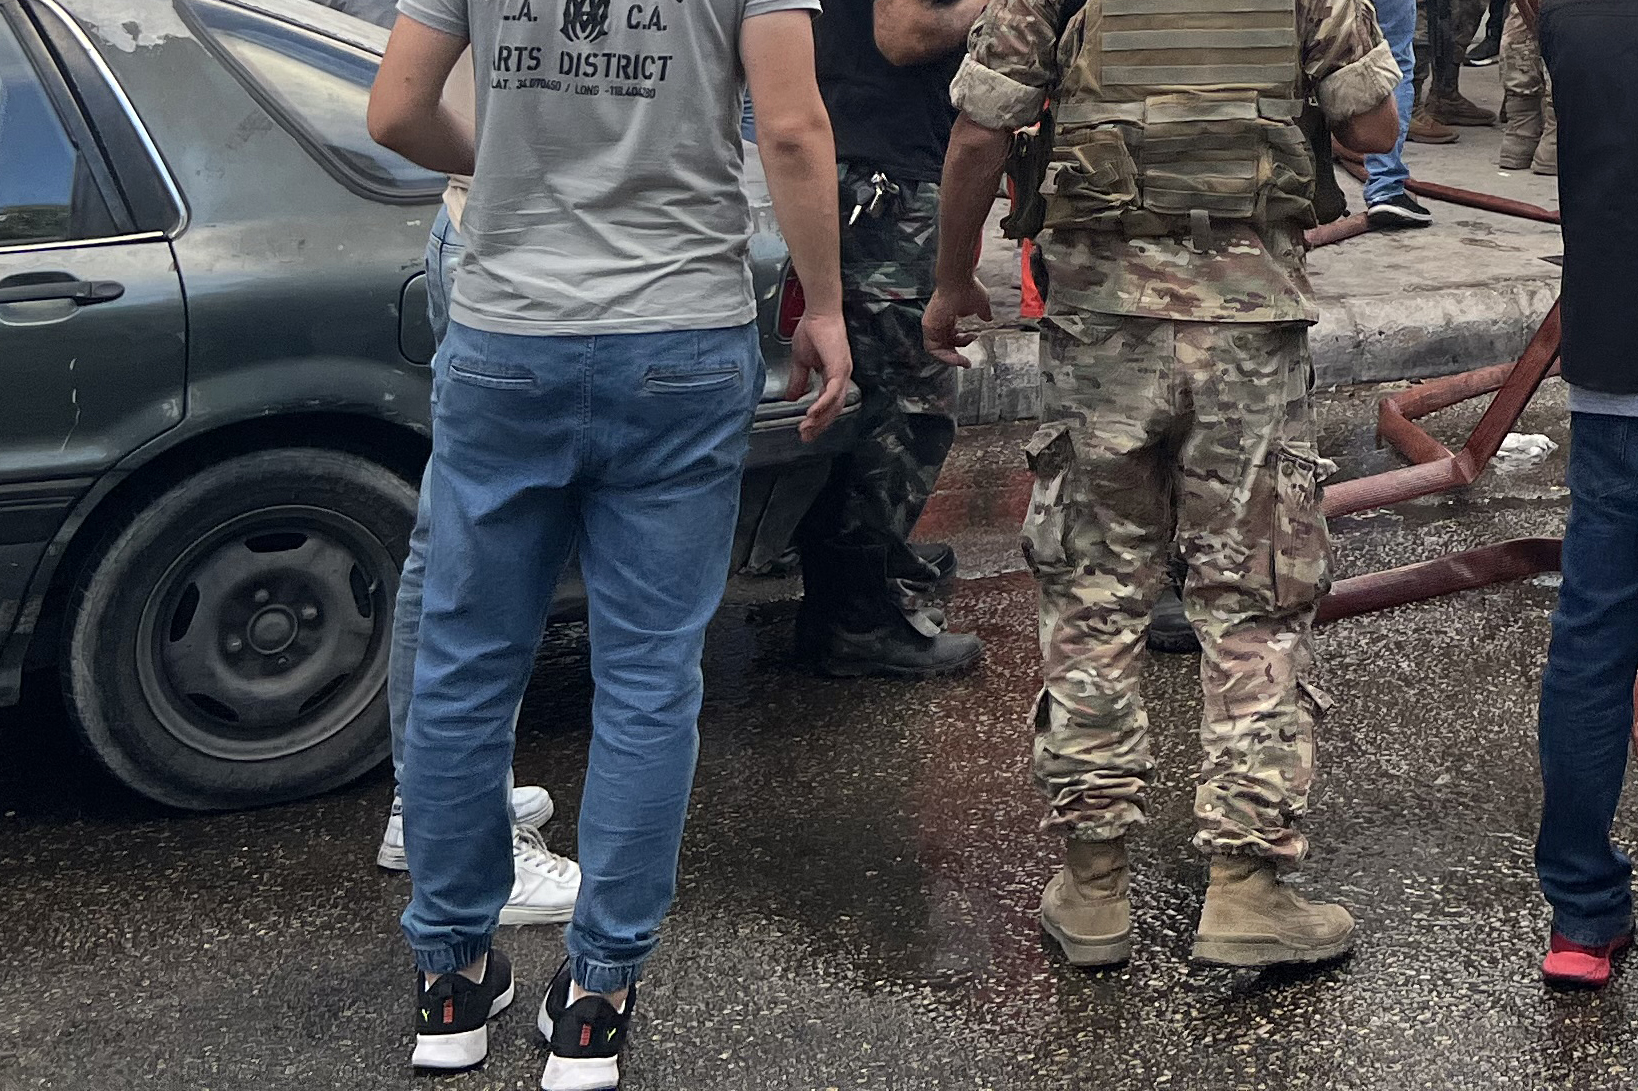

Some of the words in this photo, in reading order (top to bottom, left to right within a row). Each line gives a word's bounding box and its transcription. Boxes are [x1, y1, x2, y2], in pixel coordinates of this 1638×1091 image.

[626, 3, 668, 31] C.A.
[558, 50, 674, 82] DISTRICT
[574, 84, 600, 96] LONG
